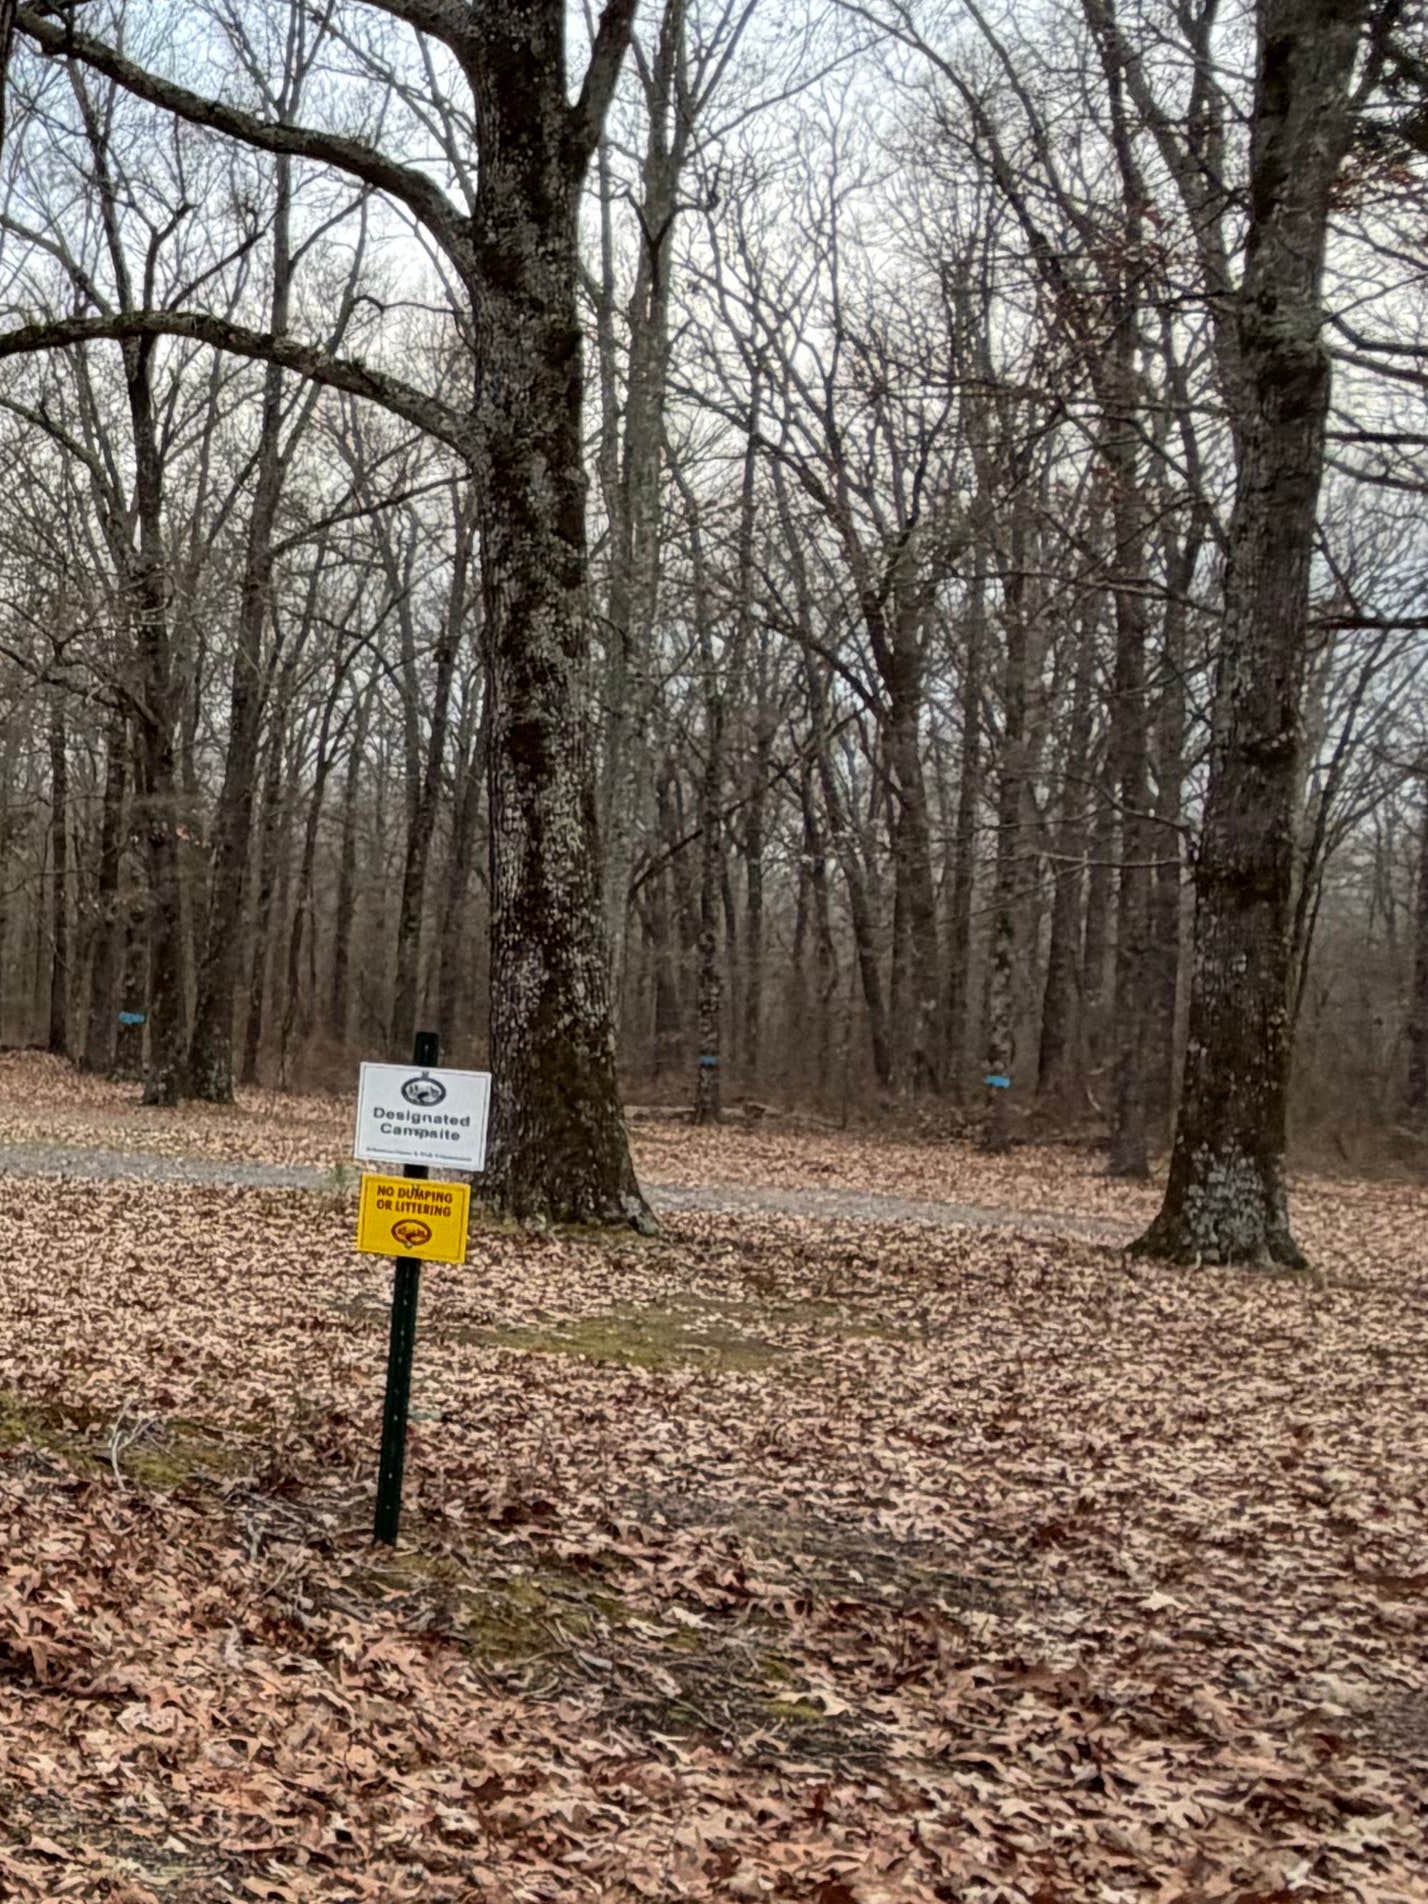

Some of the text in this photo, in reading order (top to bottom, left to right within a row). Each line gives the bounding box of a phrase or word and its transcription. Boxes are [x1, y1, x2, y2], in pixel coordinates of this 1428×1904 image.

[373, 1107, 470, 1127] Designated
[380, 1122, 460, 1141] Campsite
[377, 1185, 453, 1204] NO DUMPING
[376, 1199, 451, 1217] OR LITTERING
